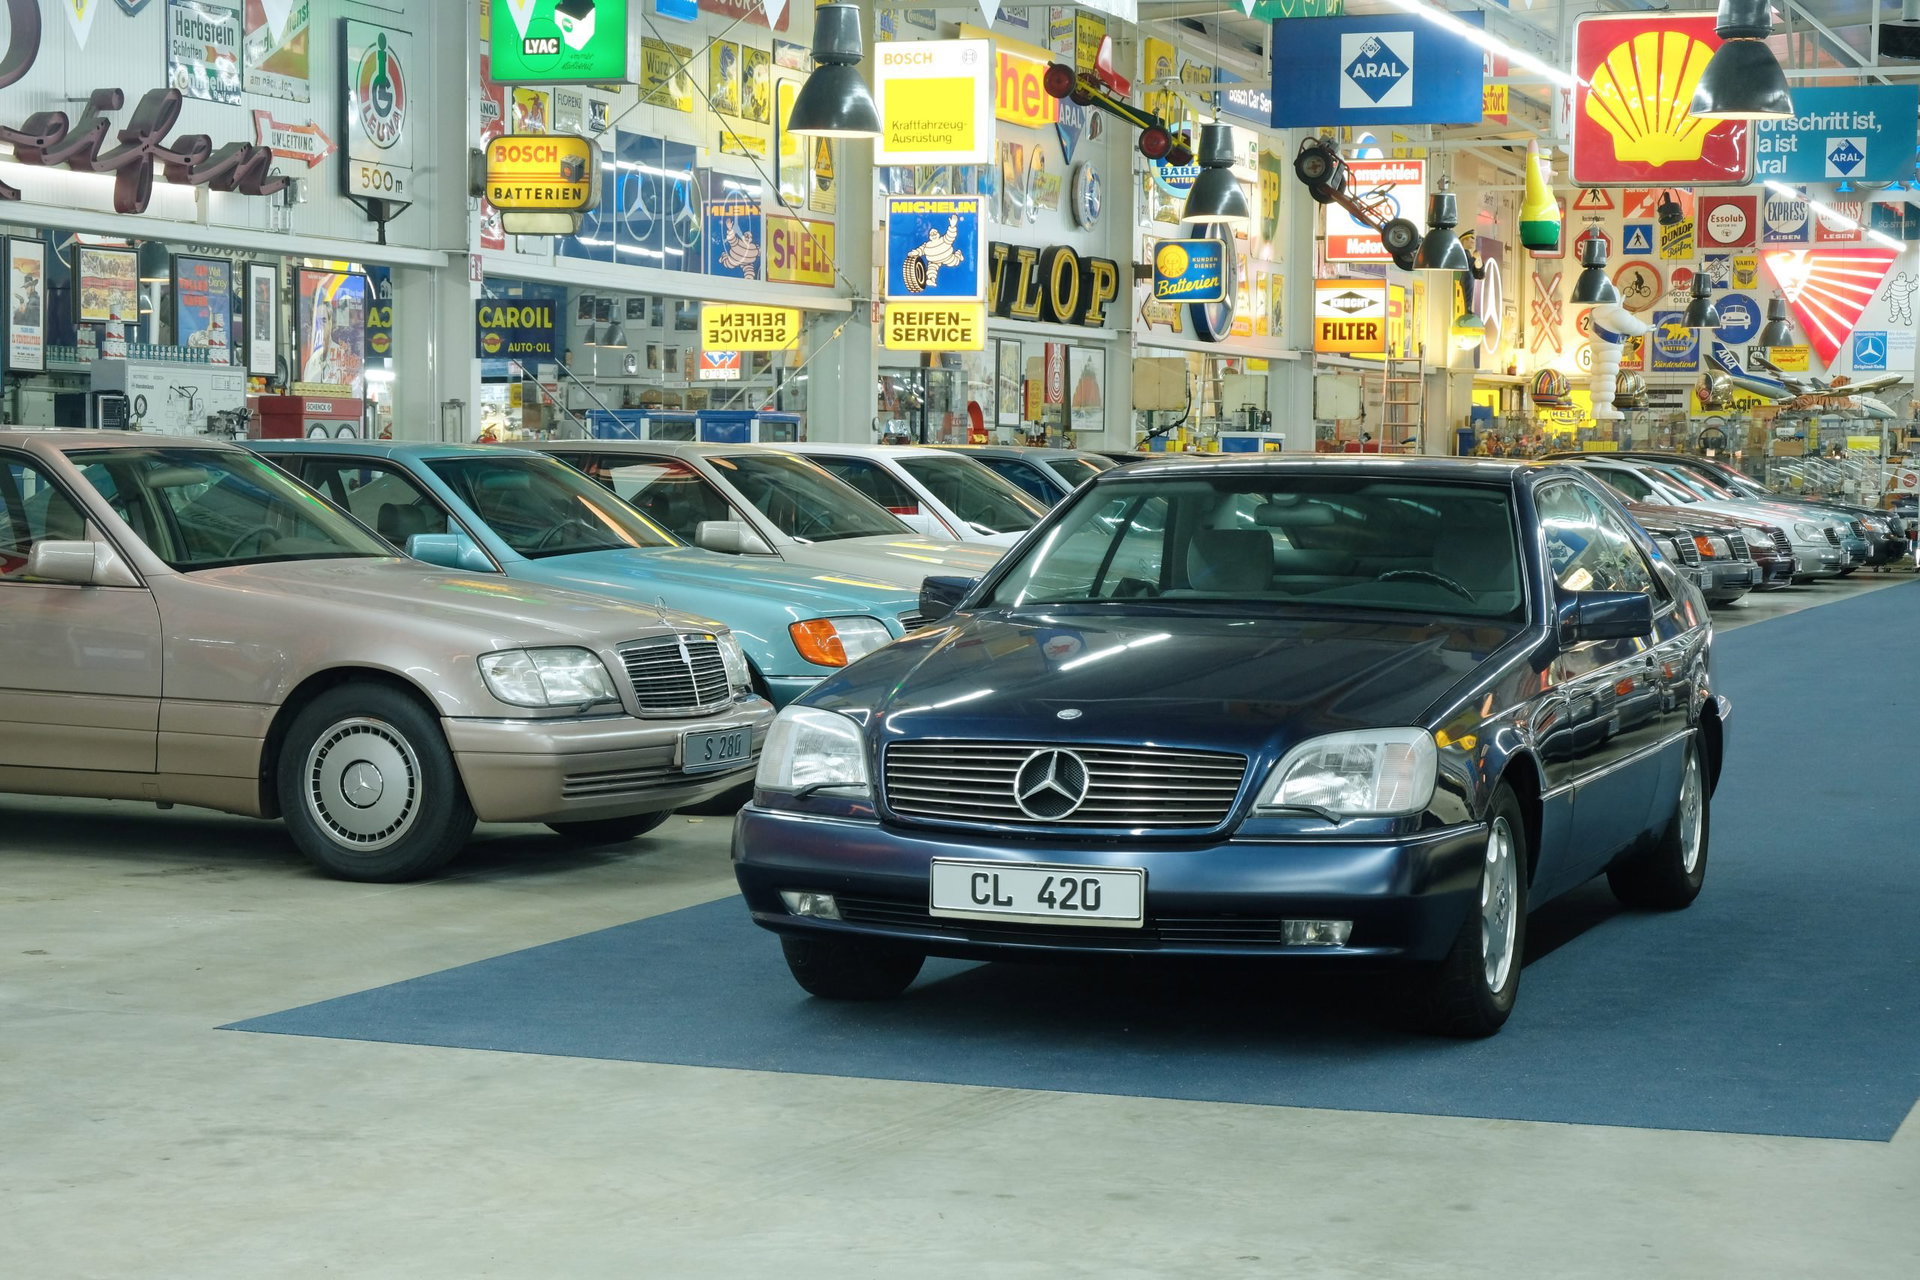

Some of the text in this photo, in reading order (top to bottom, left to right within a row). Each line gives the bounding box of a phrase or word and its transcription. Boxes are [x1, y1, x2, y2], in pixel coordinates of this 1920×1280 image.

[175, 10, 234, 46] Herbstein
[525, 38, 558, 54] LYAC
[883, 53, 933, 65] BOSCH
[1352, 62, 1401, 79] ARAL
[557, 93, 582, 109] FLORENZ
[1249, 89, 1261, 109] Car
[362, 104, 403, 142] LEUNA
[1059, 104, 1082, 126] ARAL
[1852, 111, 1882, 133] ist,
[892, 121, 968, 132] Kraftfahrzeug-
[271, 131, 314, 152] UMLEITUNG
[892, 133, 953, 144] Ausrüstung
[1774, 135, 1798, 153] ist
[495, 145, 558, 163] BOSCH
[1832, 153, 1861, 163] ARAL
[361, 167, 403, 193] 500 m
[1354, 163, 1419, 184] empfehlen
[493, 188, 582, 200] BATTERIEN
[891, 201, 977, 213] MICHELIN
[1768, 201, 1806, 222] EXPRESS
[1711, 214, 1744, 224] Essolub
[1661, 223, 1693, 246] DUNLOP
[772, 228, 830, 273] SHELL
[1346, 237, 1388, 255] Motor
[1667, 241, 1692, 257] Reifen
[1736, 260, 1755, 268] VARTA
[1156, 275, 1220, 297] Batterien
[1330, 298, 1369, 308] KNECHT
[478, 306, 553, 329] CAROIL
[893, 311, 971, 326] REIFEN-
[893, 328, 972, 342] SERVICE
[1322, 322, 1378, 341] FILTER
[508, 343, 551, 352] AUTO-OIL
[1716, 349, 1736, 370] ANA
[306, 403, 327, 412] SCHENCK
[704, 732, 742, 759] S 280
[971, 872, 1101, 911] CL 420
